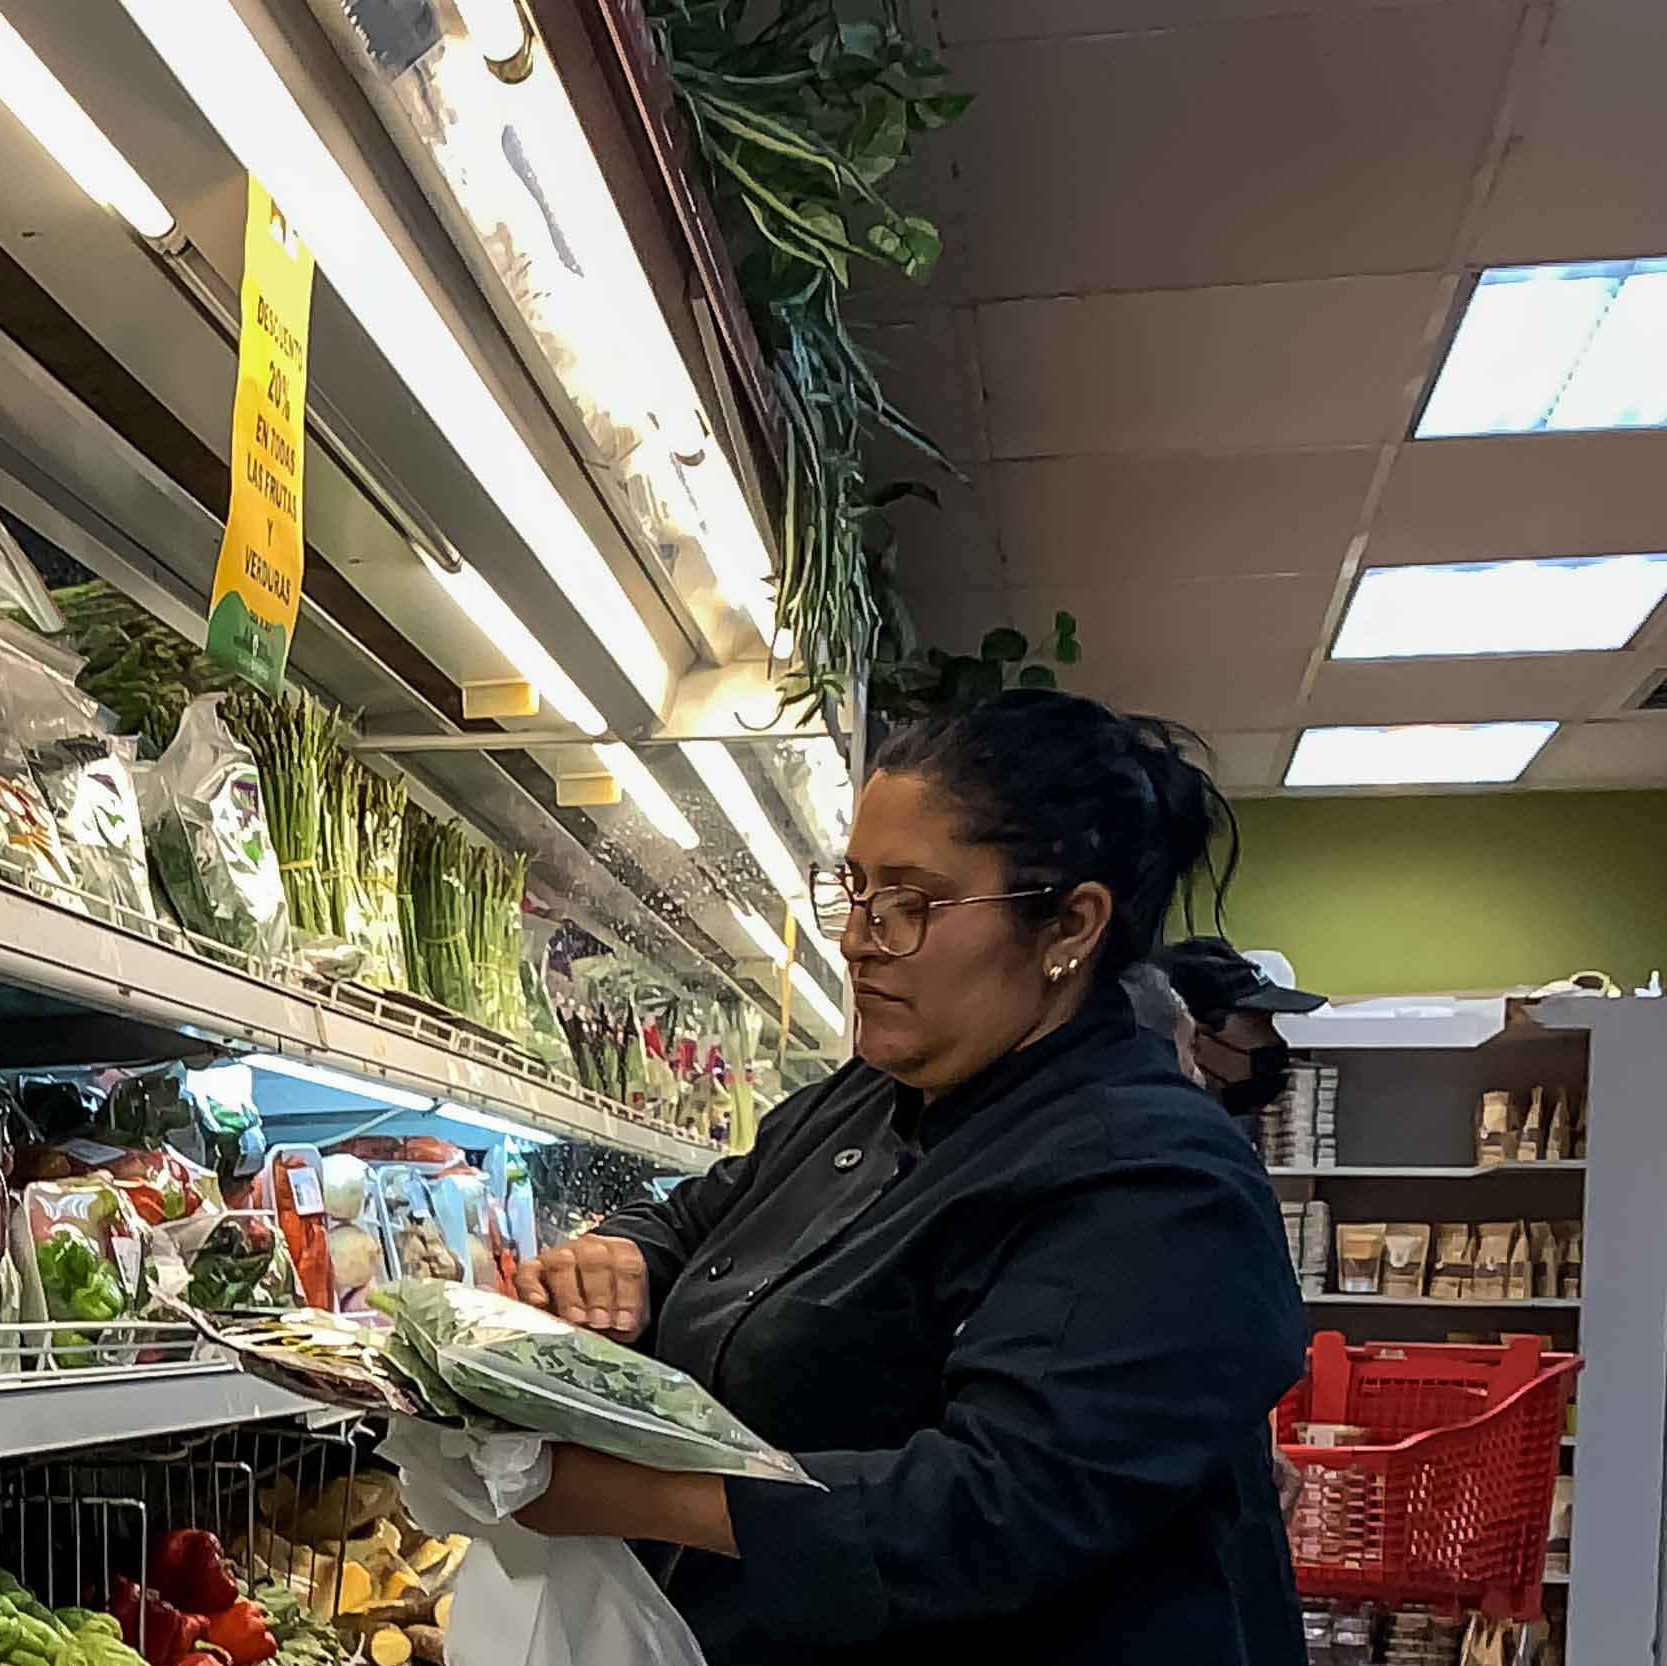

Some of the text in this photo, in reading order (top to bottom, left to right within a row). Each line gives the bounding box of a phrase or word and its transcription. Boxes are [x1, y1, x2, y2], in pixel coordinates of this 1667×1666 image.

[257, 294, 303, 372] DESCUENTO
[267, 360, 291, 422] 20%
[256, 412, 295, 476] EN TODAS
[246, 450, 297, 523] LAS FRUTAS
[266, 516, 274, 547] Y
[244, 543, 291, 606] VERDURAS
